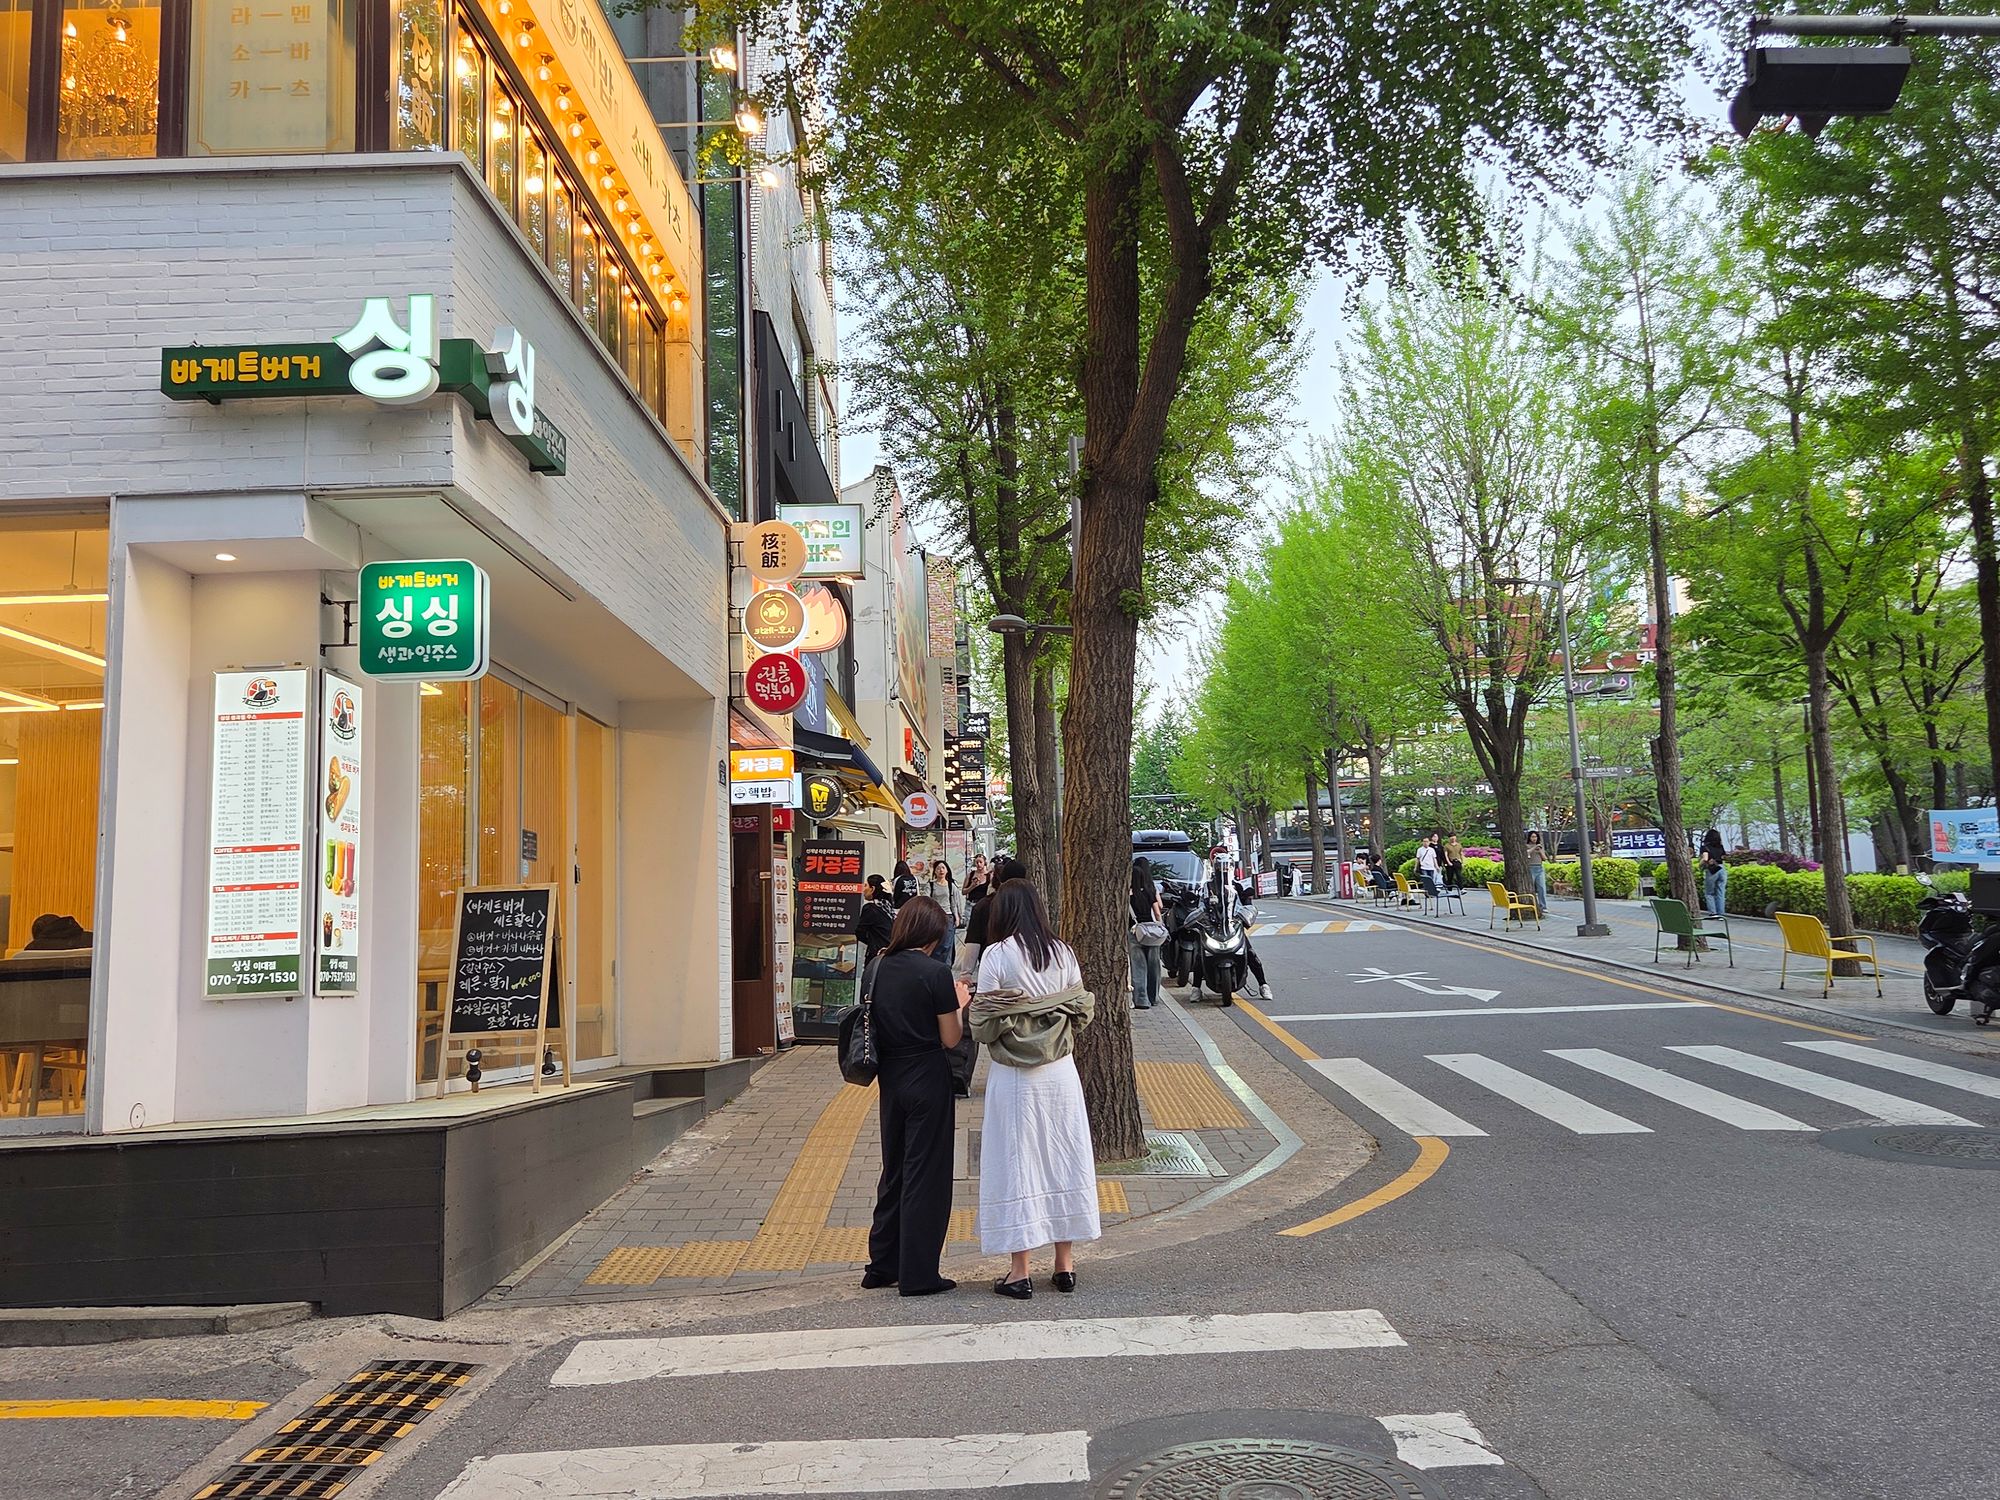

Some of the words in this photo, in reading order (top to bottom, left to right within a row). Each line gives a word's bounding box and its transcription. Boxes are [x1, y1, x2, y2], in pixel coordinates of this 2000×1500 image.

[170, 351, 321, 384] 바게트버거
[331, 292, 438, 404] 싱
[761, 532, 779, 568] 核飯
[378, 571, 458, 590] 바게트버거
[376, 594, 458, 639] 싱싱
[378, 643, 458, 664] 생과일주스
[757, 661, 791, 683] 전골
[755, 682, 795, 701] 떡볶이
[738, 757, 785, 773] 카공족
[805, 856, 860, 875] 카공족
[231, 960, 251, 972] 싱싱
[253, 961, 277, 971] 이대점
[209, 971, 297, 986] 070-7537-1530
